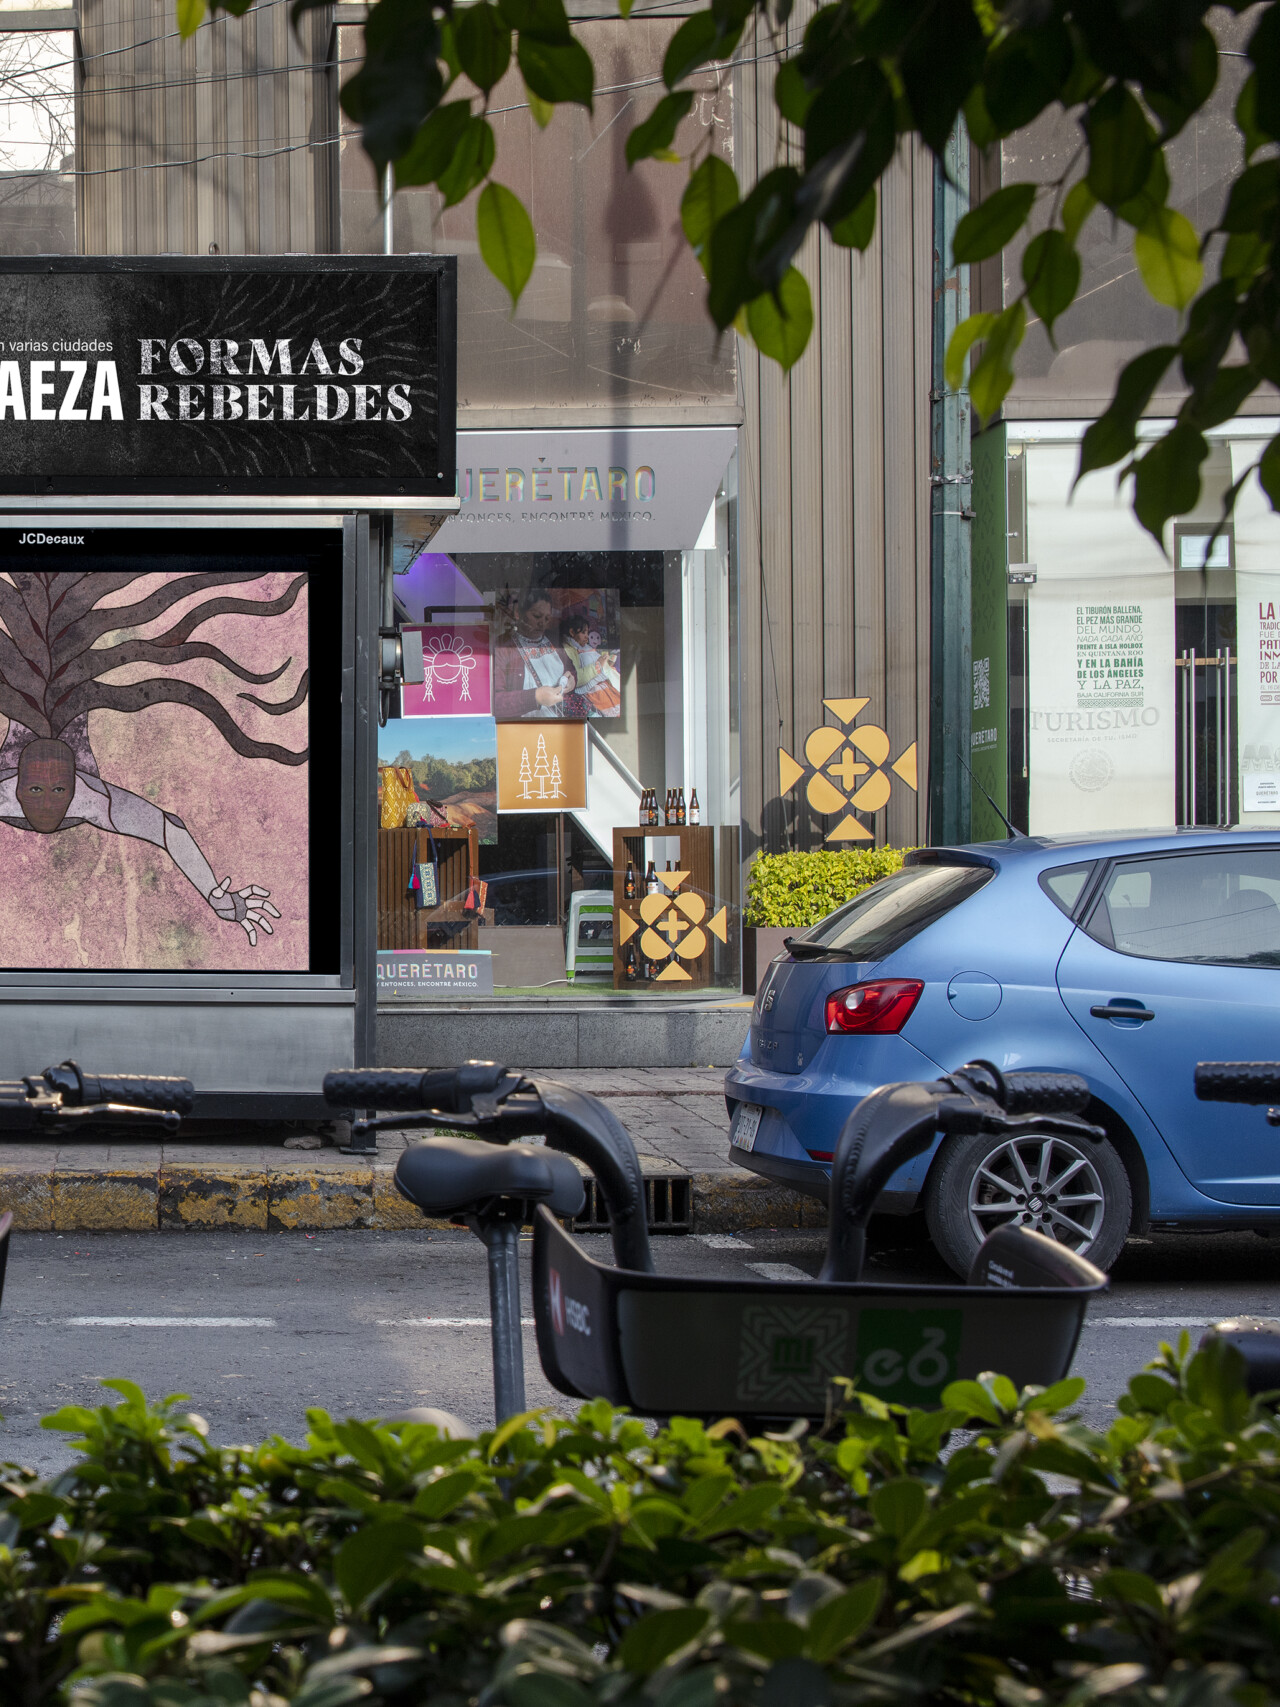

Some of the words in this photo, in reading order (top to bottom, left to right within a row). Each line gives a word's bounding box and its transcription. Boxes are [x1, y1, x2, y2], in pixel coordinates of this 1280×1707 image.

[8, 340, 49, 352] varias
[52, 339, 113, 352] ciudades
[137, 337, 365, 376] FORMAS
[137, 383, 413, 422] REBELDES
[455, 457, 656, 503] UERÉTARO
[18, 532, 85, 545] JCDecaux
[1085, 605, 1111, 614] TIBURÓN
[1113, 606, 1142, 614] BALLENA,
[1259, 602, 1276, 620] LA
[1077, 617, 1084, 625] EL
[1086, 616, 1098, 625] PEZ
[1100, 615, 1114, 624] MÁS
[1116, 615, 1142, 624] GRANDE
[1077, 626, 1096, 634] DEL
[1099, 625, 1142, 634] MUNDO,
[1077, 659, 1083, 668] Y
[1086, 659, 1096, 668] EN
[1100, 659, 1111, 668] LA
[1114, 656, 1143, 667] BAHÍA
[1077, 671, 1087, 679] DE
[1090, 670, 1104, 678] LOS
[1107, 669, 1143, 678] ÁNGELES
[1260, 671, 1278, 683] POR
[1077, 681, 1087, 690] Y
[1094, 680, 1112, 689] LA
[1115, 679, 1144, 690] PAZ,
[1031, 706, 1161, 732] TURISMO
[376, 959, 478, 980] QUERÉTARO
